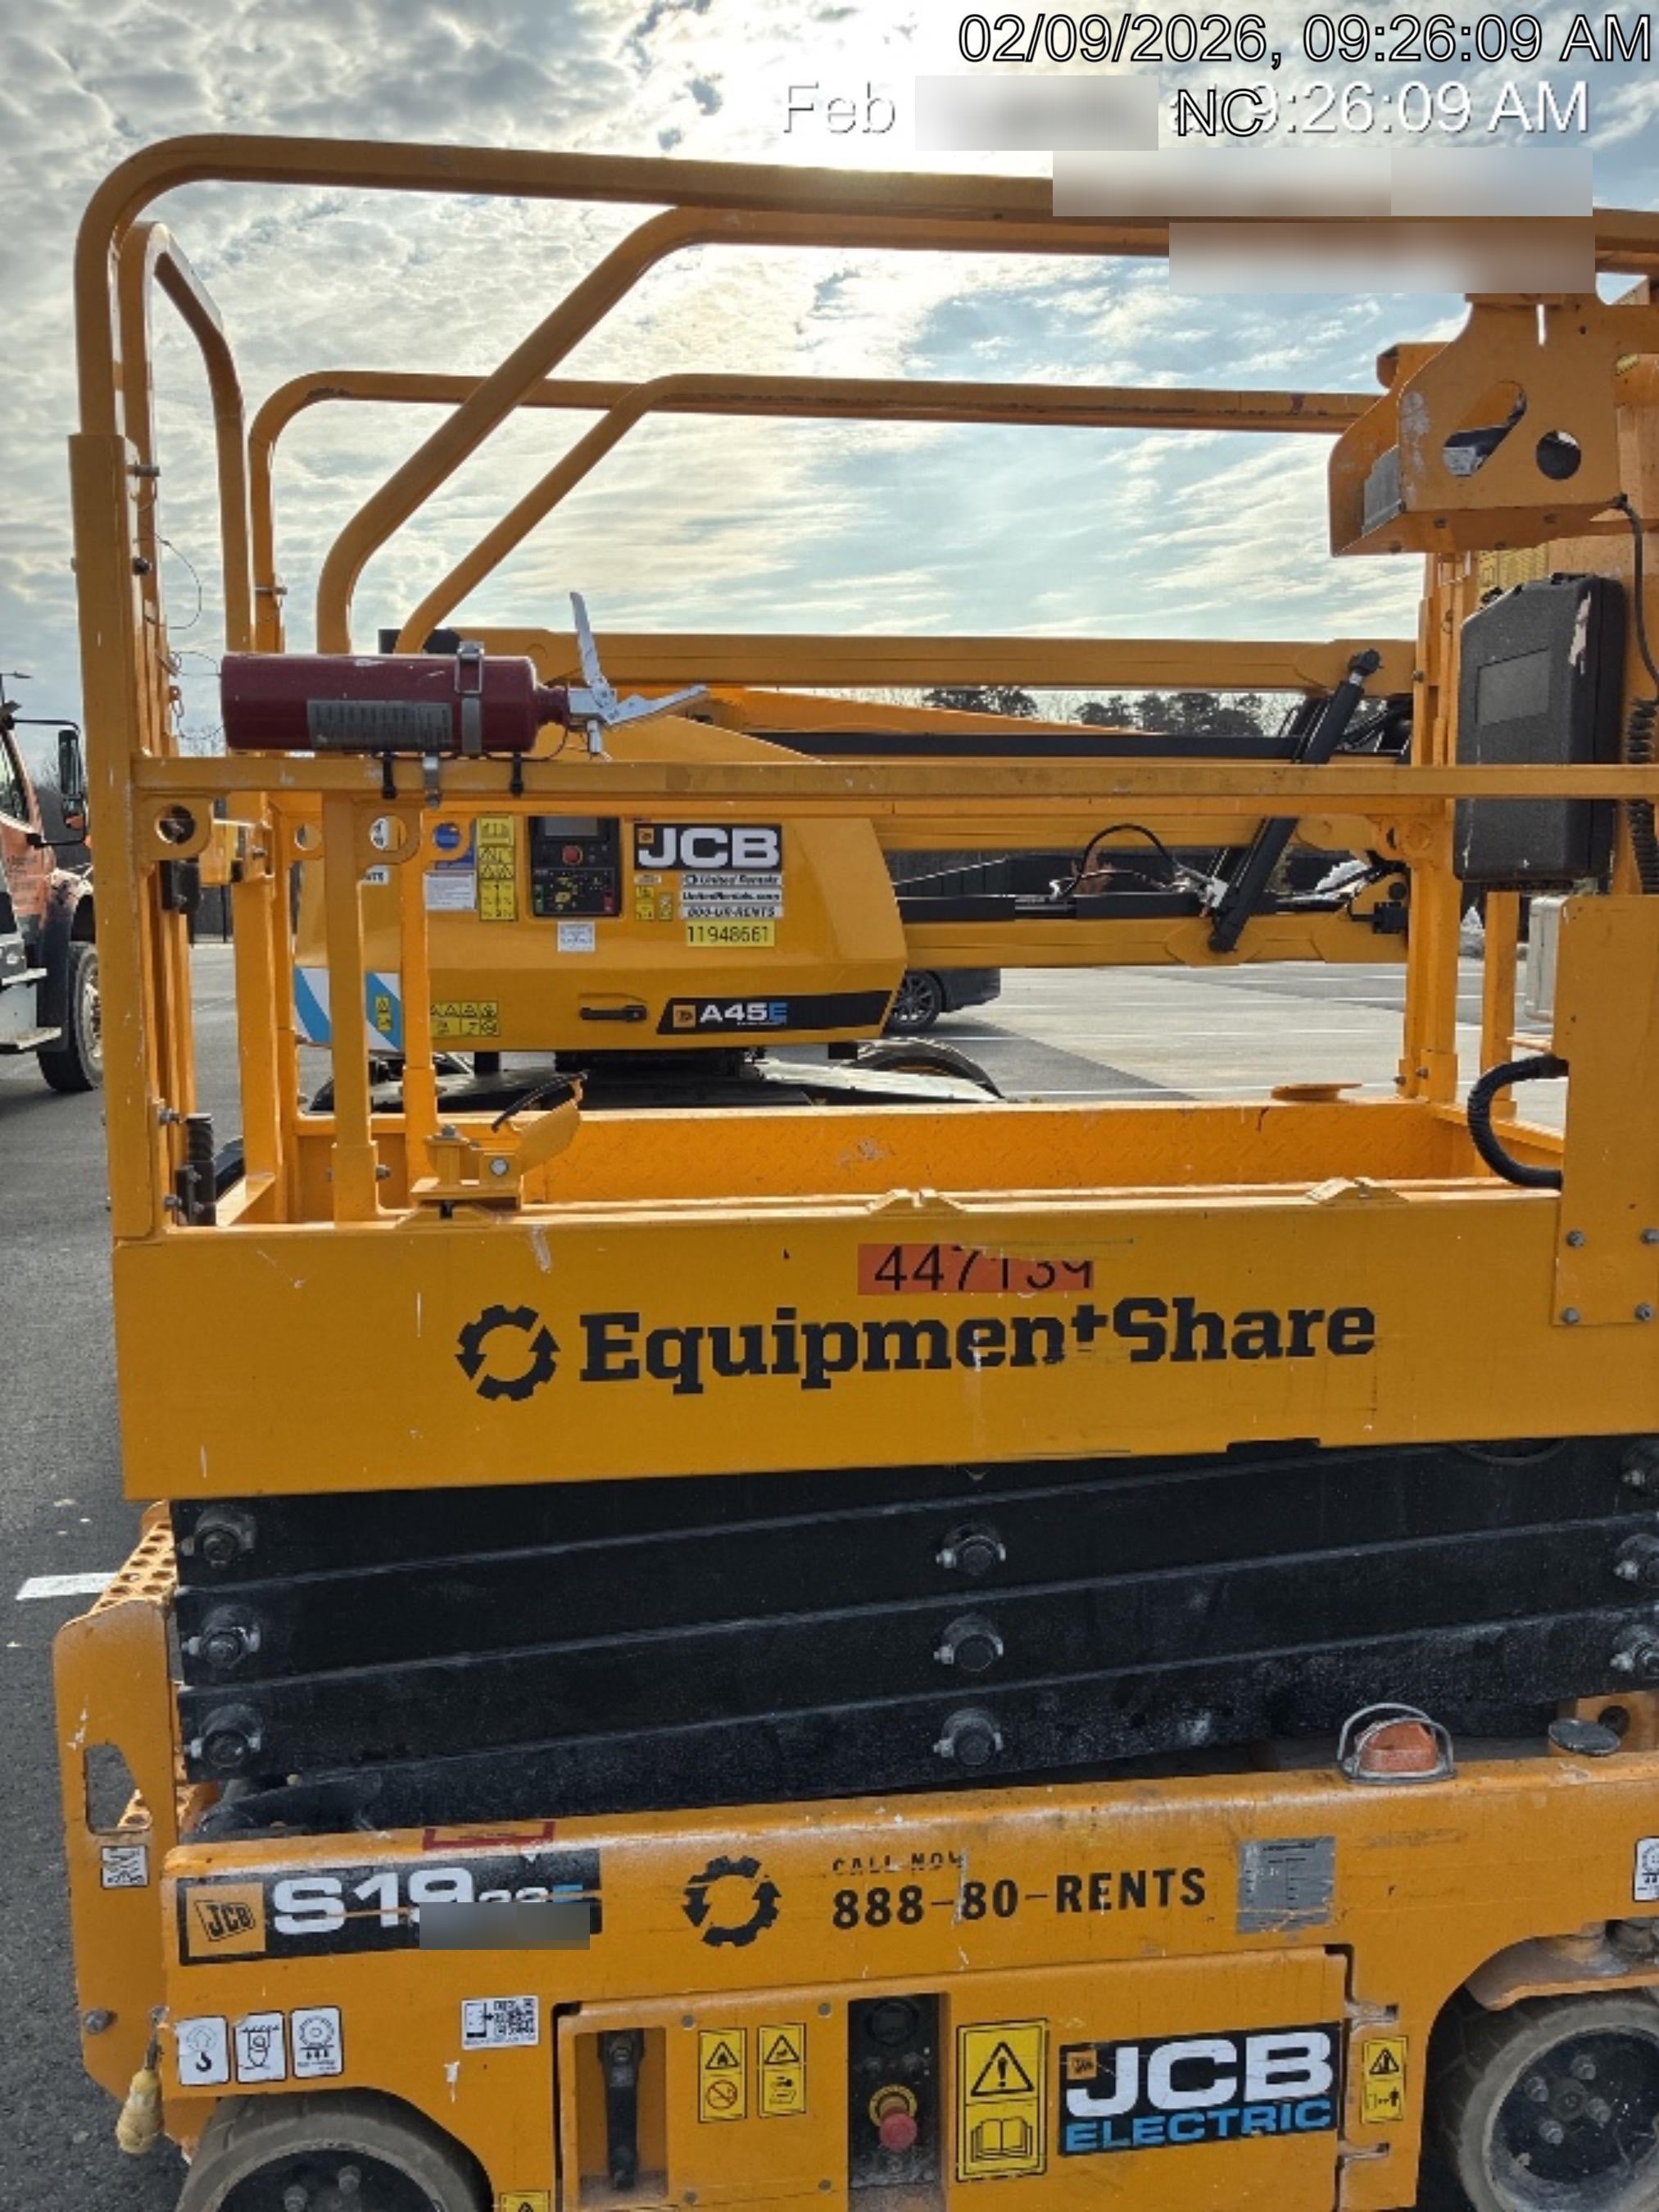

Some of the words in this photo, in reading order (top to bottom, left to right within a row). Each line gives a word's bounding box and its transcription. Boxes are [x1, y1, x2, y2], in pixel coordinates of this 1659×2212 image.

[638, 827, 780, 868] JCB
[700, 1002, 787, 1023] A45E
[579, 1297, 1376, 1394] EquipmentShare
[204, 1902, 252, 1938] JCB
[1066, 2032, 1333, 2117] JCB
[1066, 2097, 1331, 2152] ELECTRIC
